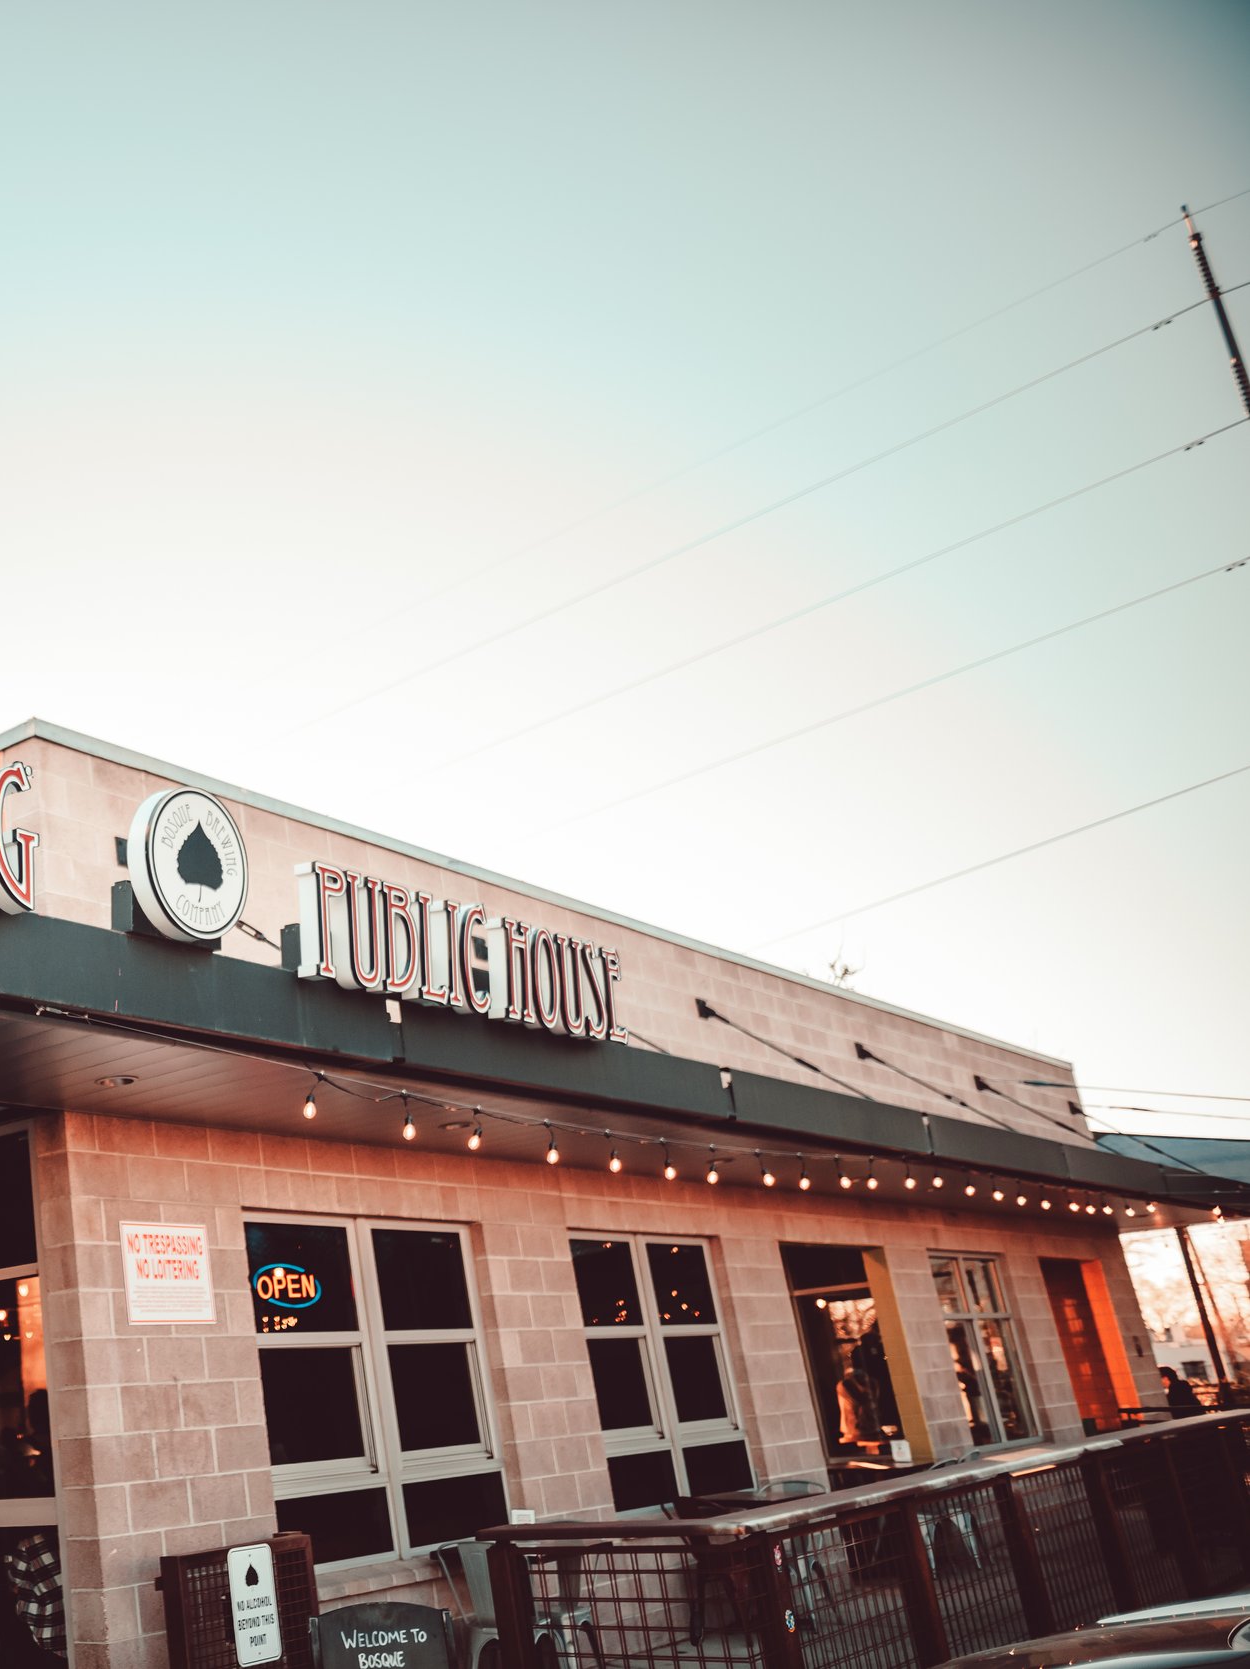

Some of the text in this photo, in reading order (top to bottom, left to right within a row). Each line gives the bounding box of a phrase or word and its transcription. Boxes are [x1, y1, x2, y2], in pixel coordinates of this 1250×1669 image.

[161, 804, 194, 848] BOSQUE
[206, 810, 238, 877] BREWING
[176, 894, 226, 926] COMPANY
[300, 861, 628, 1045] PUBLIC HOUSE
[127, 1233, 203, 1255] NO TRESPASSING
[135, 1259, 199, 1280] NO LOITERING
[257, 1273, 316, 1300] OPEN
[237, 1596, 272, 1611] NO ALCOHOL
[238, 1613, 275, 1631] BEYOND THIS
[250, 1633, 267, 1647] POINT
[341, 1629, 408, 1649] WELCOME
[358, 1651, 406, 1669] BOSQUE
